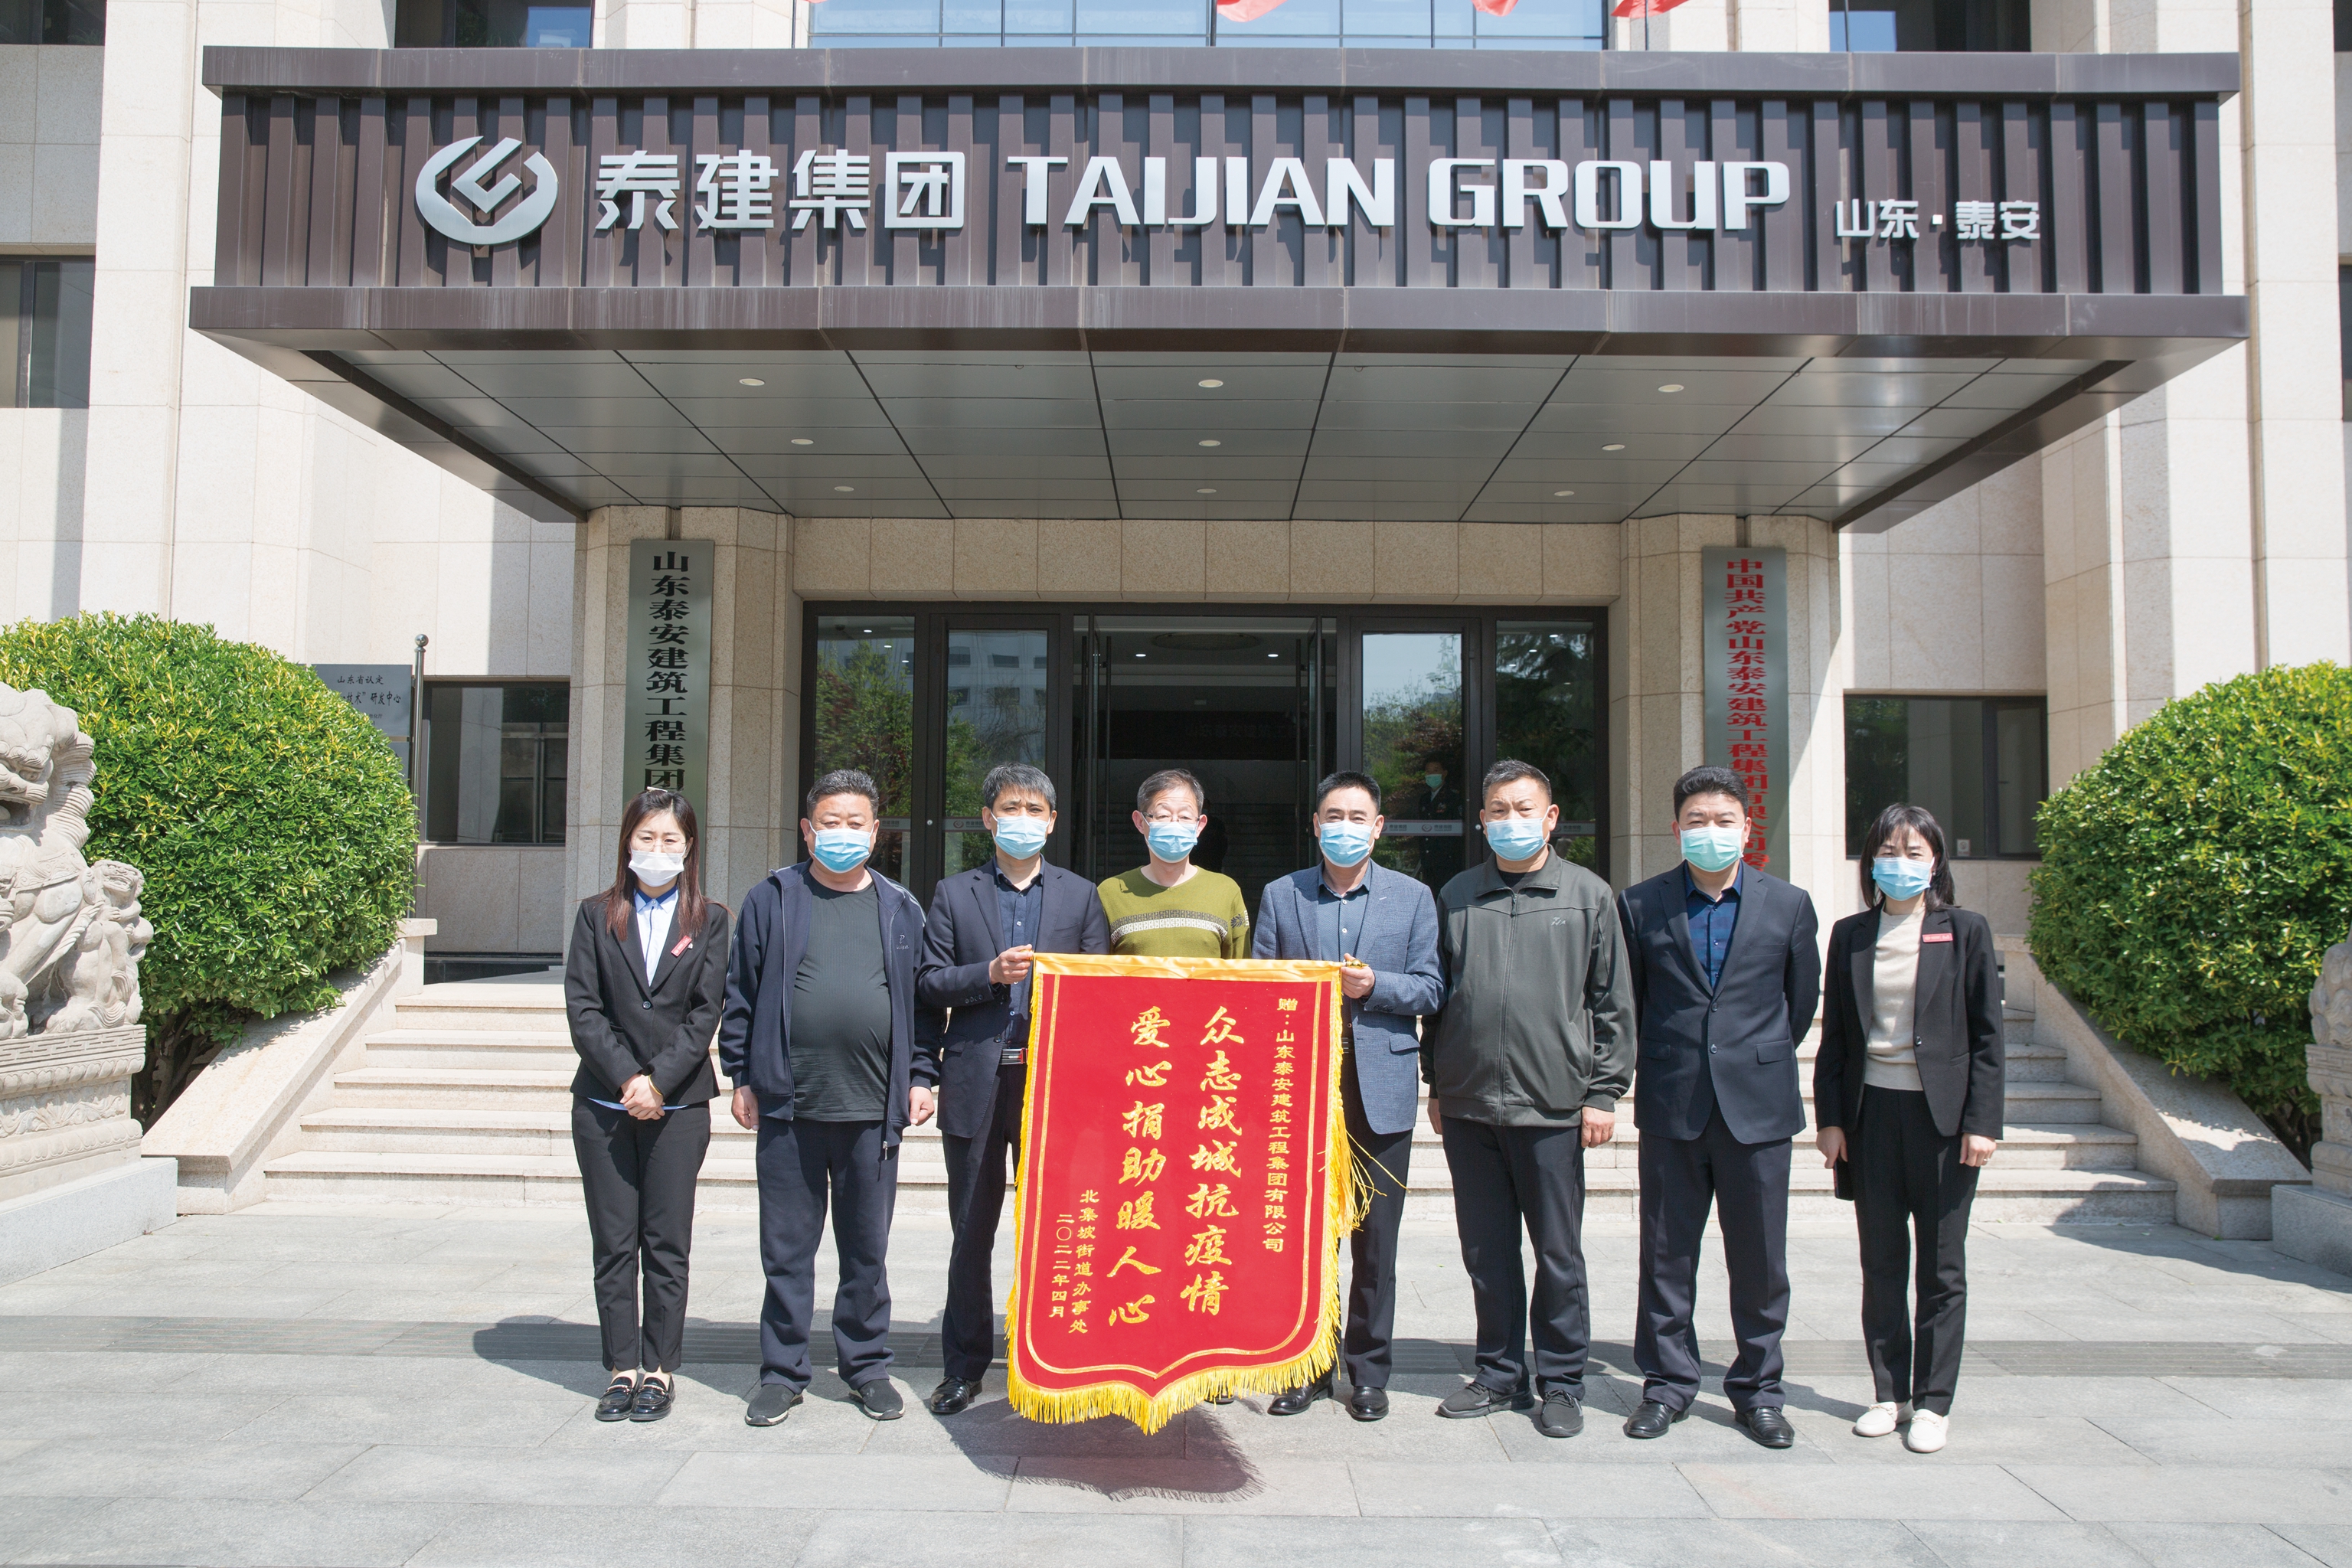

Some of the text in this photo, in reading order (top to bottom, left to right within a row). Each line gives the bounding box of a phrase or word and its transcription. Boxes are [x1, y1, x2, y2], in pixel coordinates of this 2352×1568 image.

[595, 149, 966, 230] 泰建集团
[1007, 155, 1791, 230] TAIJIAN GROUP
[337, 674, 384, 685] 山东省认定
[644, 550, 691, 792] 山东泰安建筑工程集团
[1106, 1004, 1173, 1327] 爱心捐助暖人心
[1180, 1005, 1245, 1316] 众志成城抗疫情
[1068, 1189, 1100, 1334] 北集坡街道办事处
